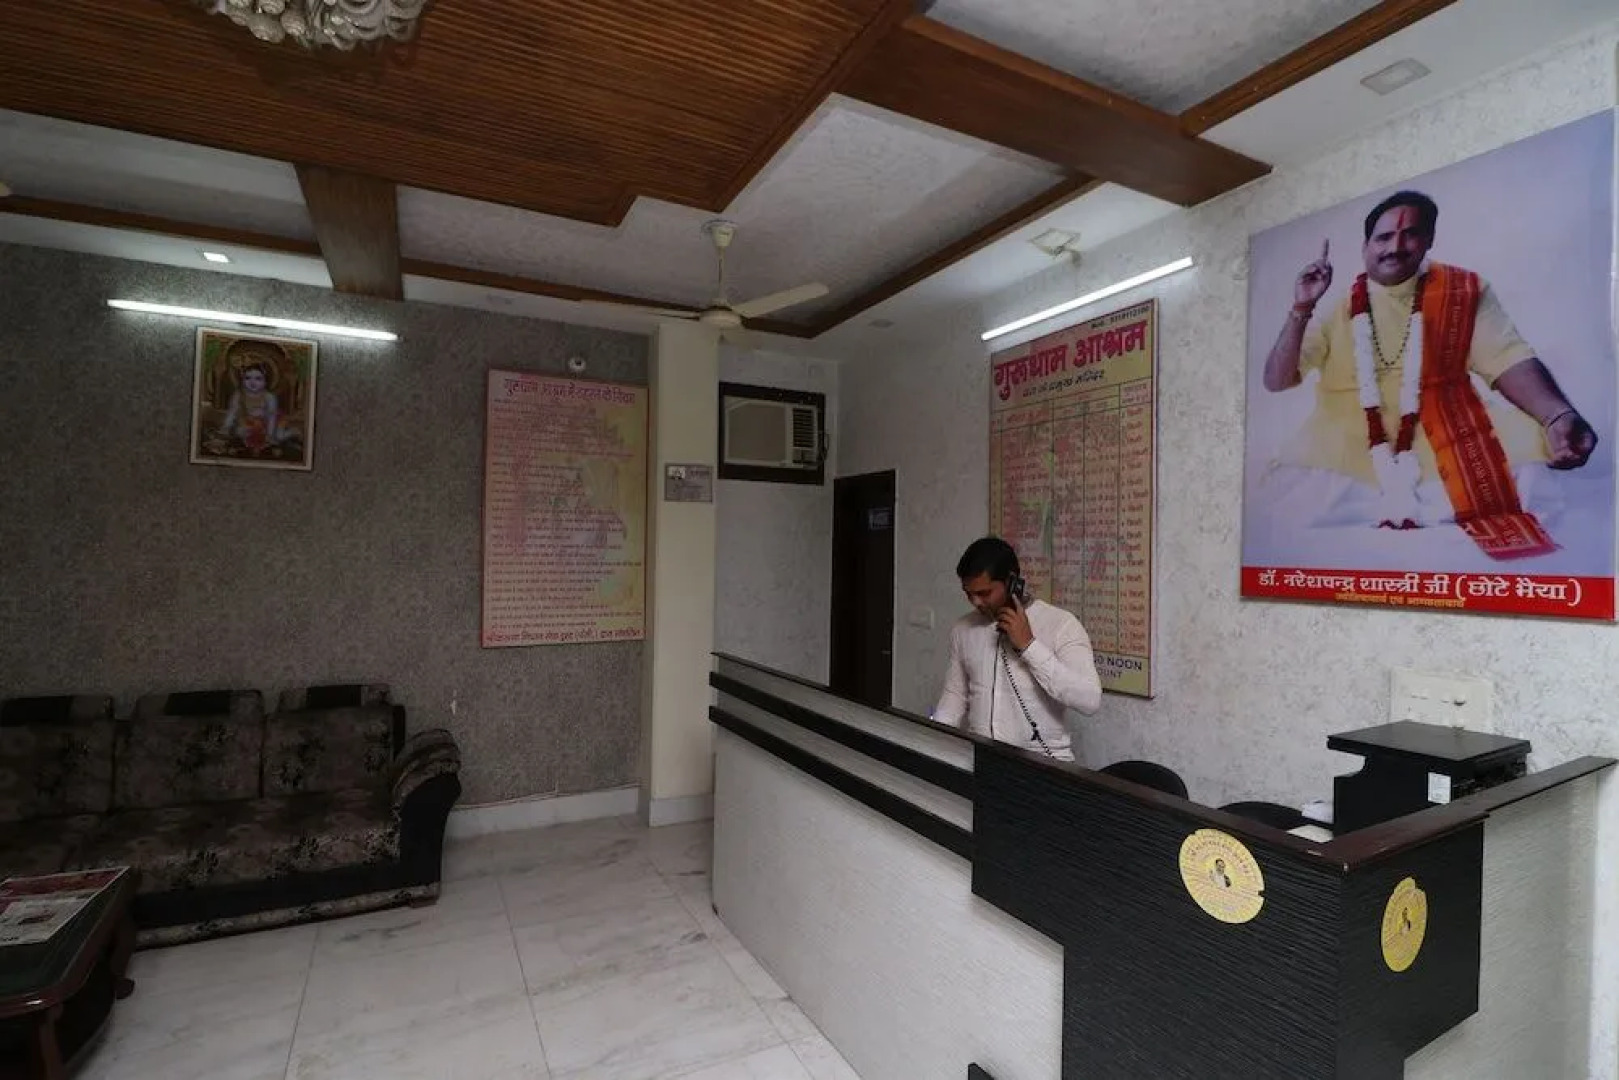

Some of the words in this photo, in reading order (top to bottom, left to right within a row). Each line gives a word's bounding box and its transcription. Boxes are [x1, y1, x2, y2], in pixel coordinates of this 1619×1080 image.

[1073, 320, 1149, 368] आश्रम
[1258, 569, 1280, 587] डॉ.
[1284, 570, 1356, 592] नरेशचन्द्र
[1360, 572, 1420, 593] शास्त्री
[1423, 574, 1451, 594] जी
[1107, 656, 1142, 671] NOON
